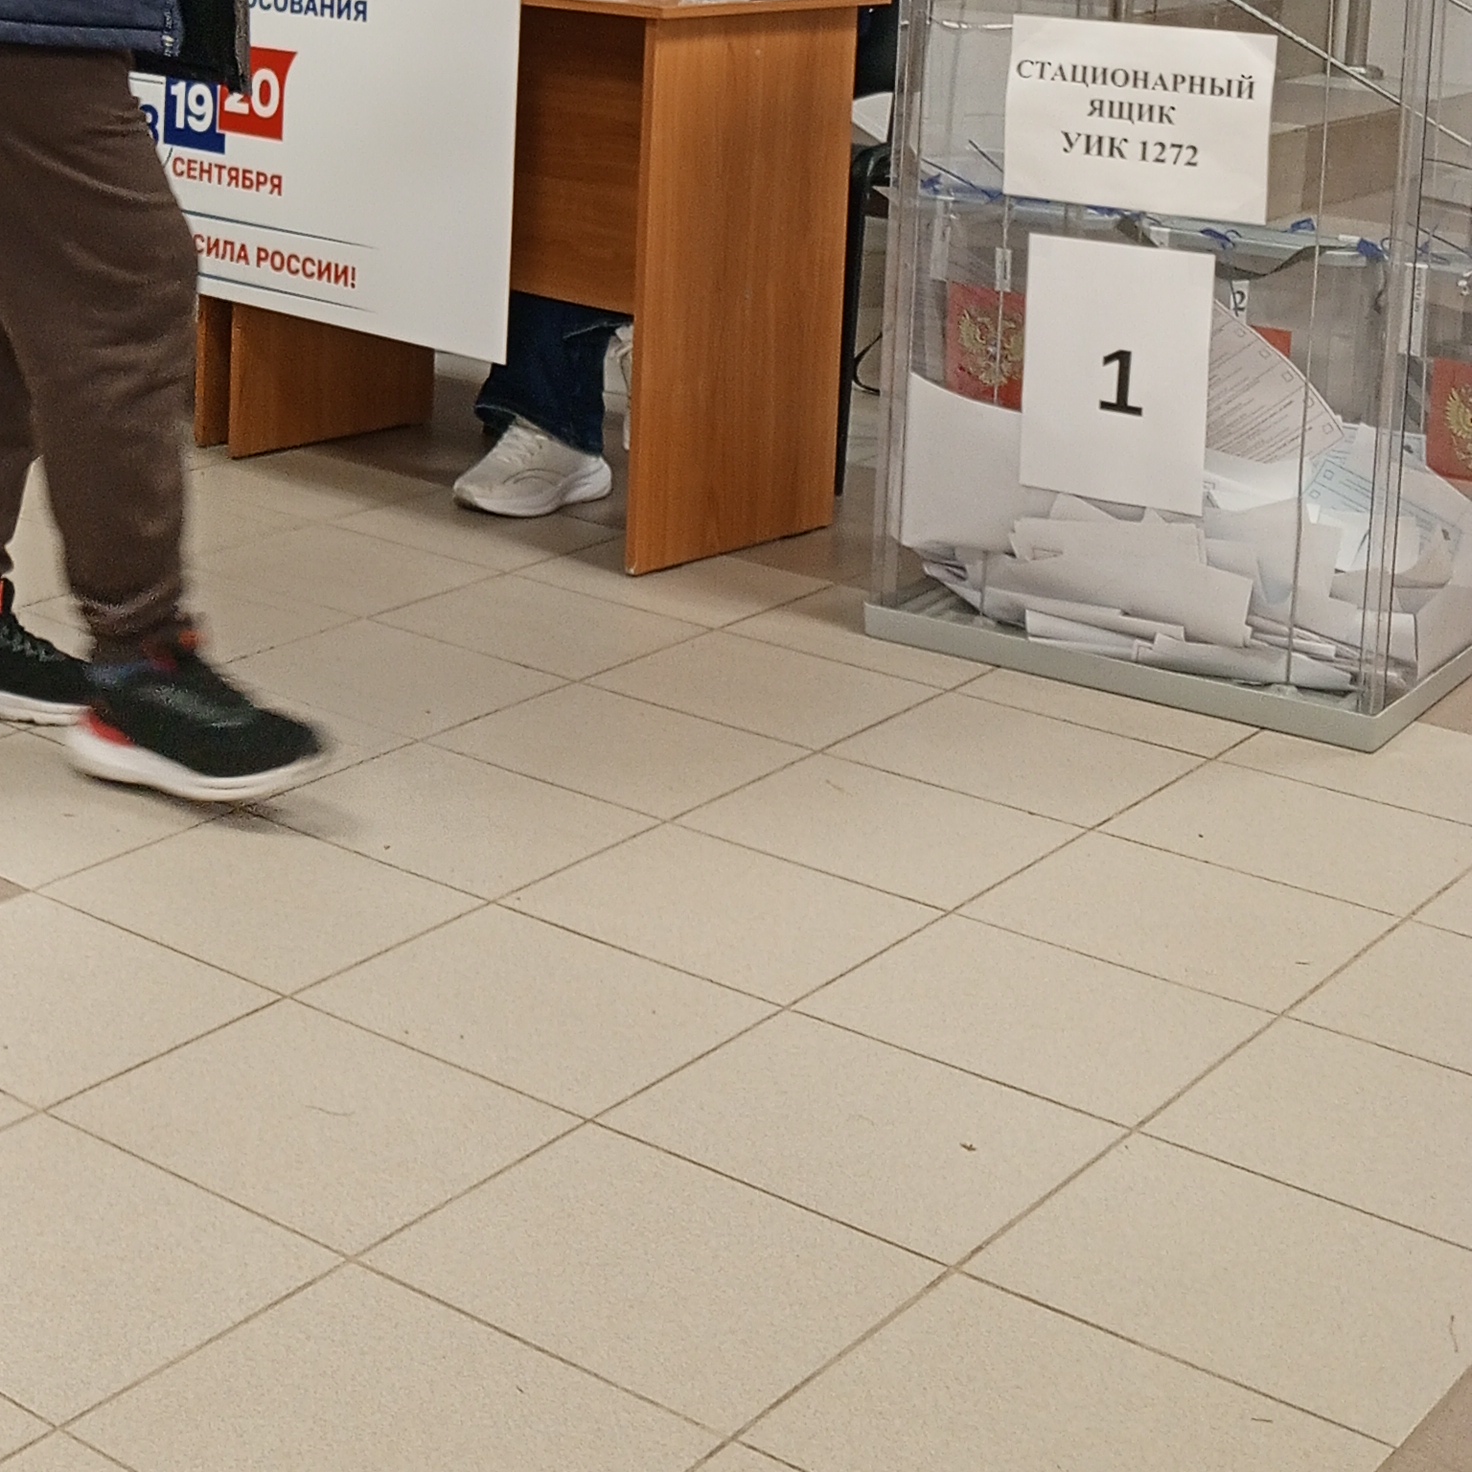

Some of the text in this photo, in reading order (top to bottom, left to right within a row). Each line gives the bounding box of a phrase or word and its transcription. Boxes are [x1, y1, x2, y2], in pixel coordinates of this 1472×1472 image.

[1016, 59, 1256, 101] СТАЦИОНАРНЫЙ
[170, 79, 214, 132] 19
[1087, 98, 1177, 125] ЯЩИК
[1060, 130, 1200, 168] УИК 1272
[172, 156, 283, 197] СЕНТЯБРЯ
[193, 234, 357, 289] СИЛА РОССИИ!
[1098, 349, 1144, 418] 1
